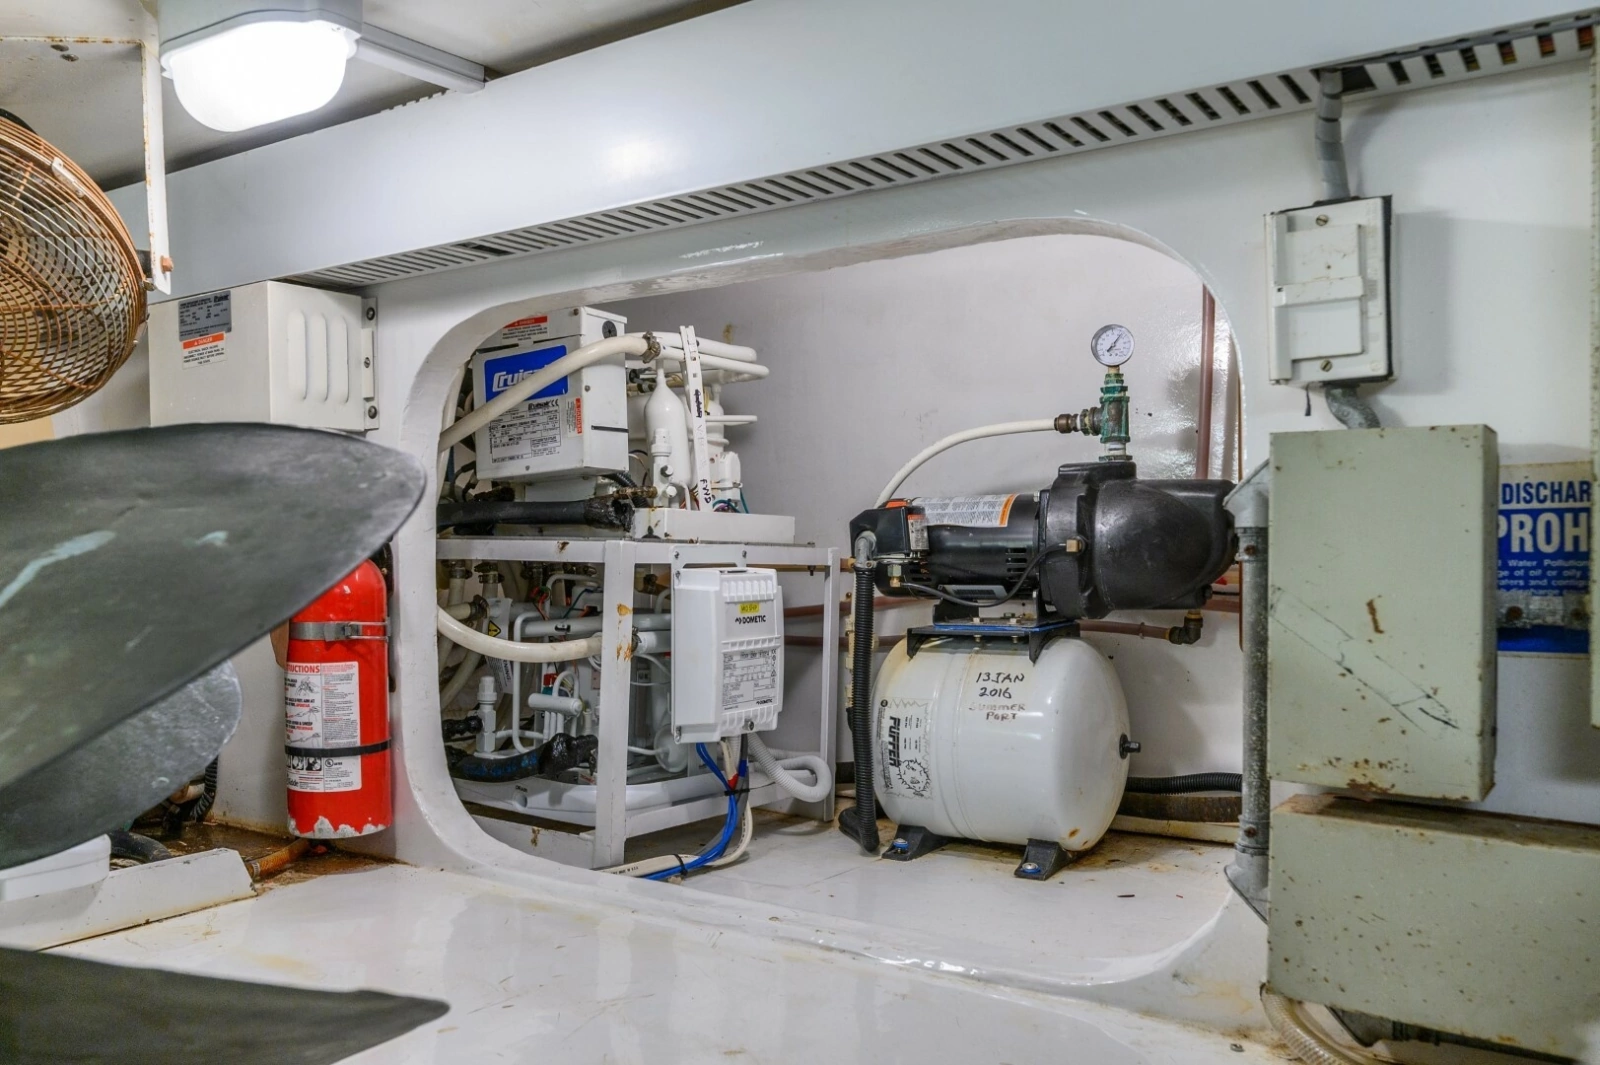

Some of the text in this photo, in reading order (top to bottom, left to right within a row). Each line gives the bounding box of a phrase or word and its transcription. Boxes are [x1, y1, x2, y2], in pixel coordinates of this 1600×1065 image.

[1508, 559, 1538, 567] Water
[742, 615, 767, 624] DOMETIC
[979, 686, 1012, 699] 2016
[888, 715, 901, 768] PUFFER
